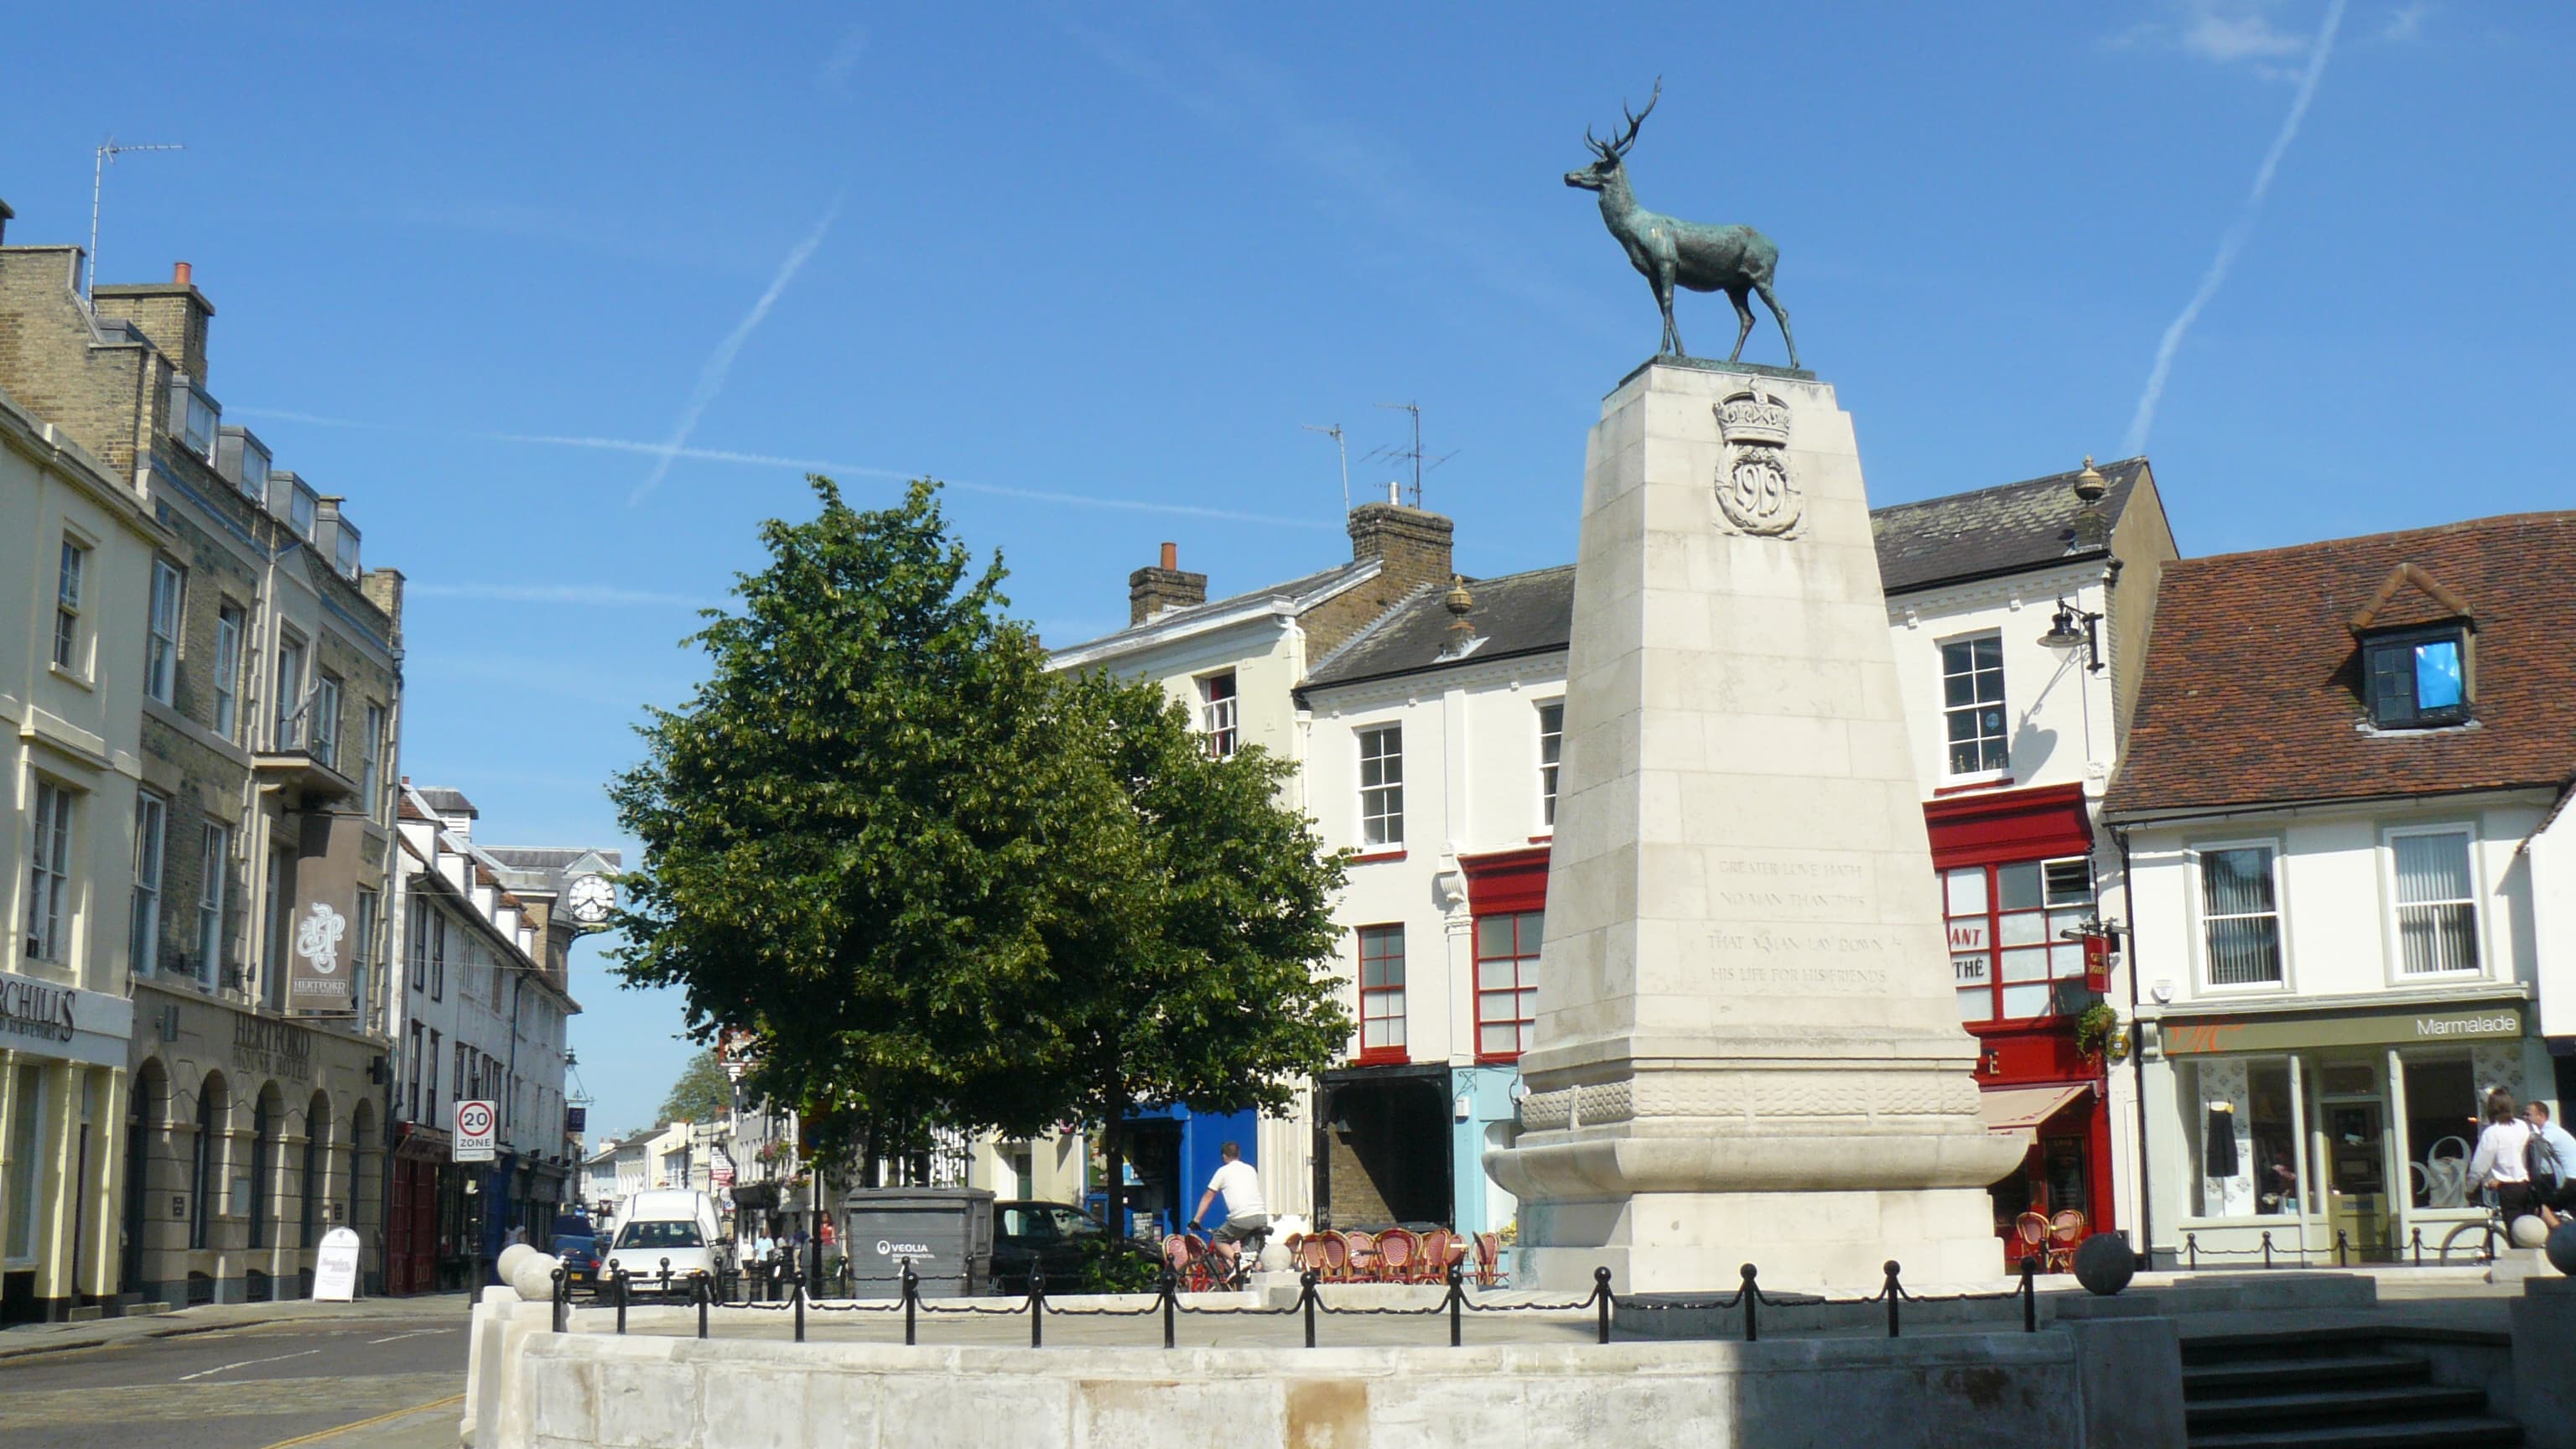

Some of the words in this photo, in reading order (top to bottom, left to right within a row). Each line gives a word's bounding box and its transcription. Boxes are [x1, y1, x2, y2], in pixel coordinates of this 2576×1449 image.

[1719, 860, 1779, 875] GREATER
[1784, 862, 1819, 877] LOVE
[1824, 864, 1862, 879] HATH
[1838, 937, 1884, 953] DOWN
[1711, 967, 1735, 981] HIS
[1739, 968, 1766, 982] LIFE
[1770, 969, 1798, 983] FOR
[1802, 969, 1826, 983] HIS
[1828, 969, 1887, 984] FRIENDS
[2417, 1015, 2516, 1036] Marmalade
[464, 1112, 488, 1126] 20
[460, 1139, 491, 1147] ZONE
[891, 1244, 928, 1252] VEOLIA
